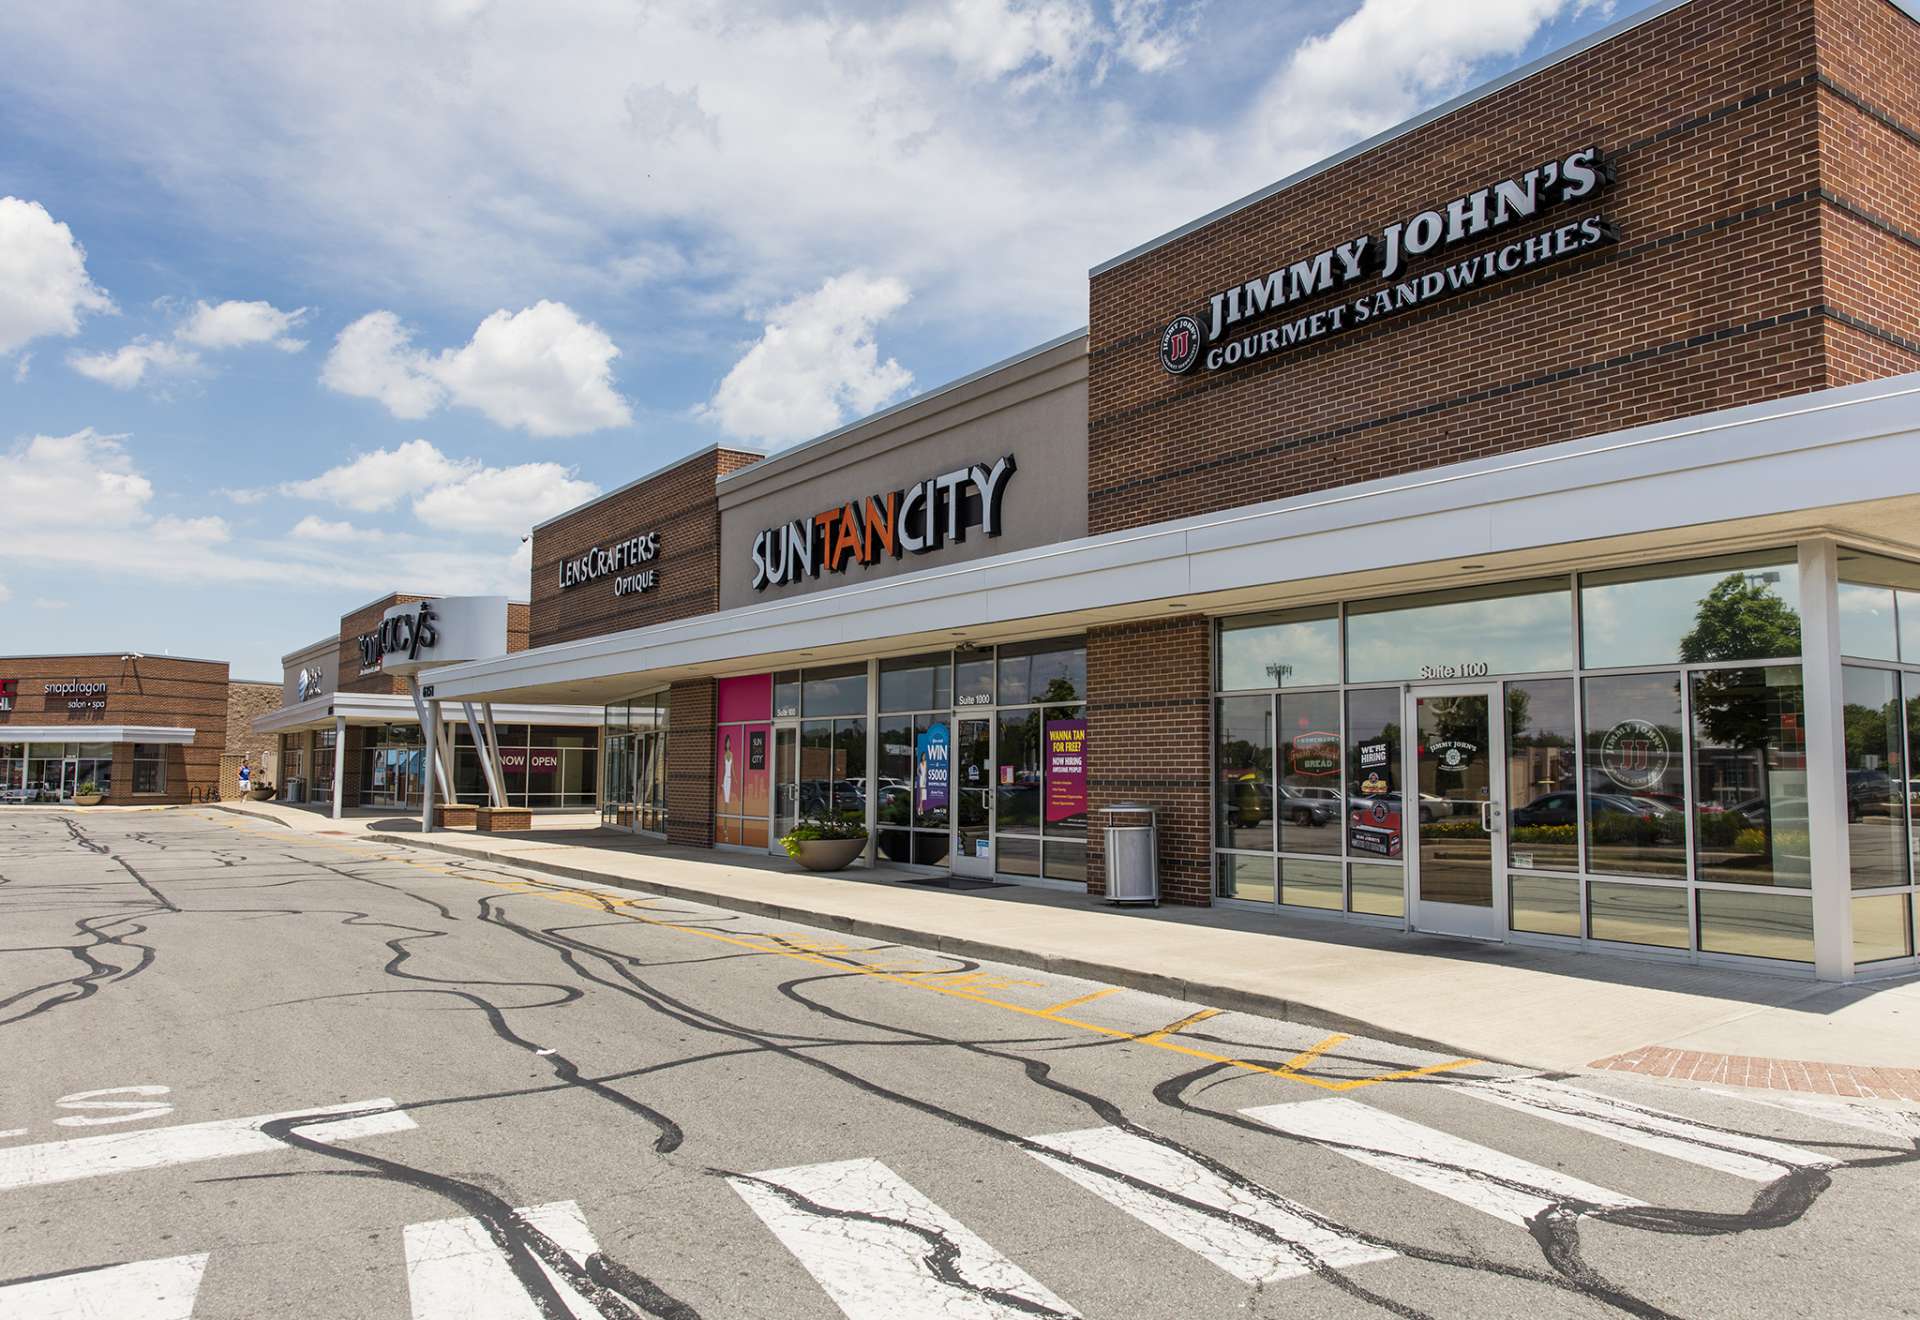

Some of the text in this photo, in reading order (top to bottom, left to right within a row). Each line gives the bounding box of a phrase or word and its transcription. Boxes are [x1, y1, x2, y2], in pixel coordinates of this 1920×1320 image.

[1208, 147, 1598, 342] JIMMY JOHN'S
[1206, 215, 1603, 371] GOURMET SANDWICHES
[614, 570, 654, 596] OPTIQUE
[1420, 662, 1488, 679] Suite 1100
[44, 678, 106, 696] snapdragon
[67, 698, 105, 709] salon spa
[959, 694, 990, 705] Suite 1000
[1050, 729, 1085, 741] WANNA TAN
[927, 744, 948, 761] WIN
[1053, 742, 1064, 753] FOR
[1361, 743, 1386, 755] WE'RE
[531, 757, 557, 766] OPEN
[1361, 751, 1387, 764] HIRING
[1304, 759, 1333, 769] BREAD
